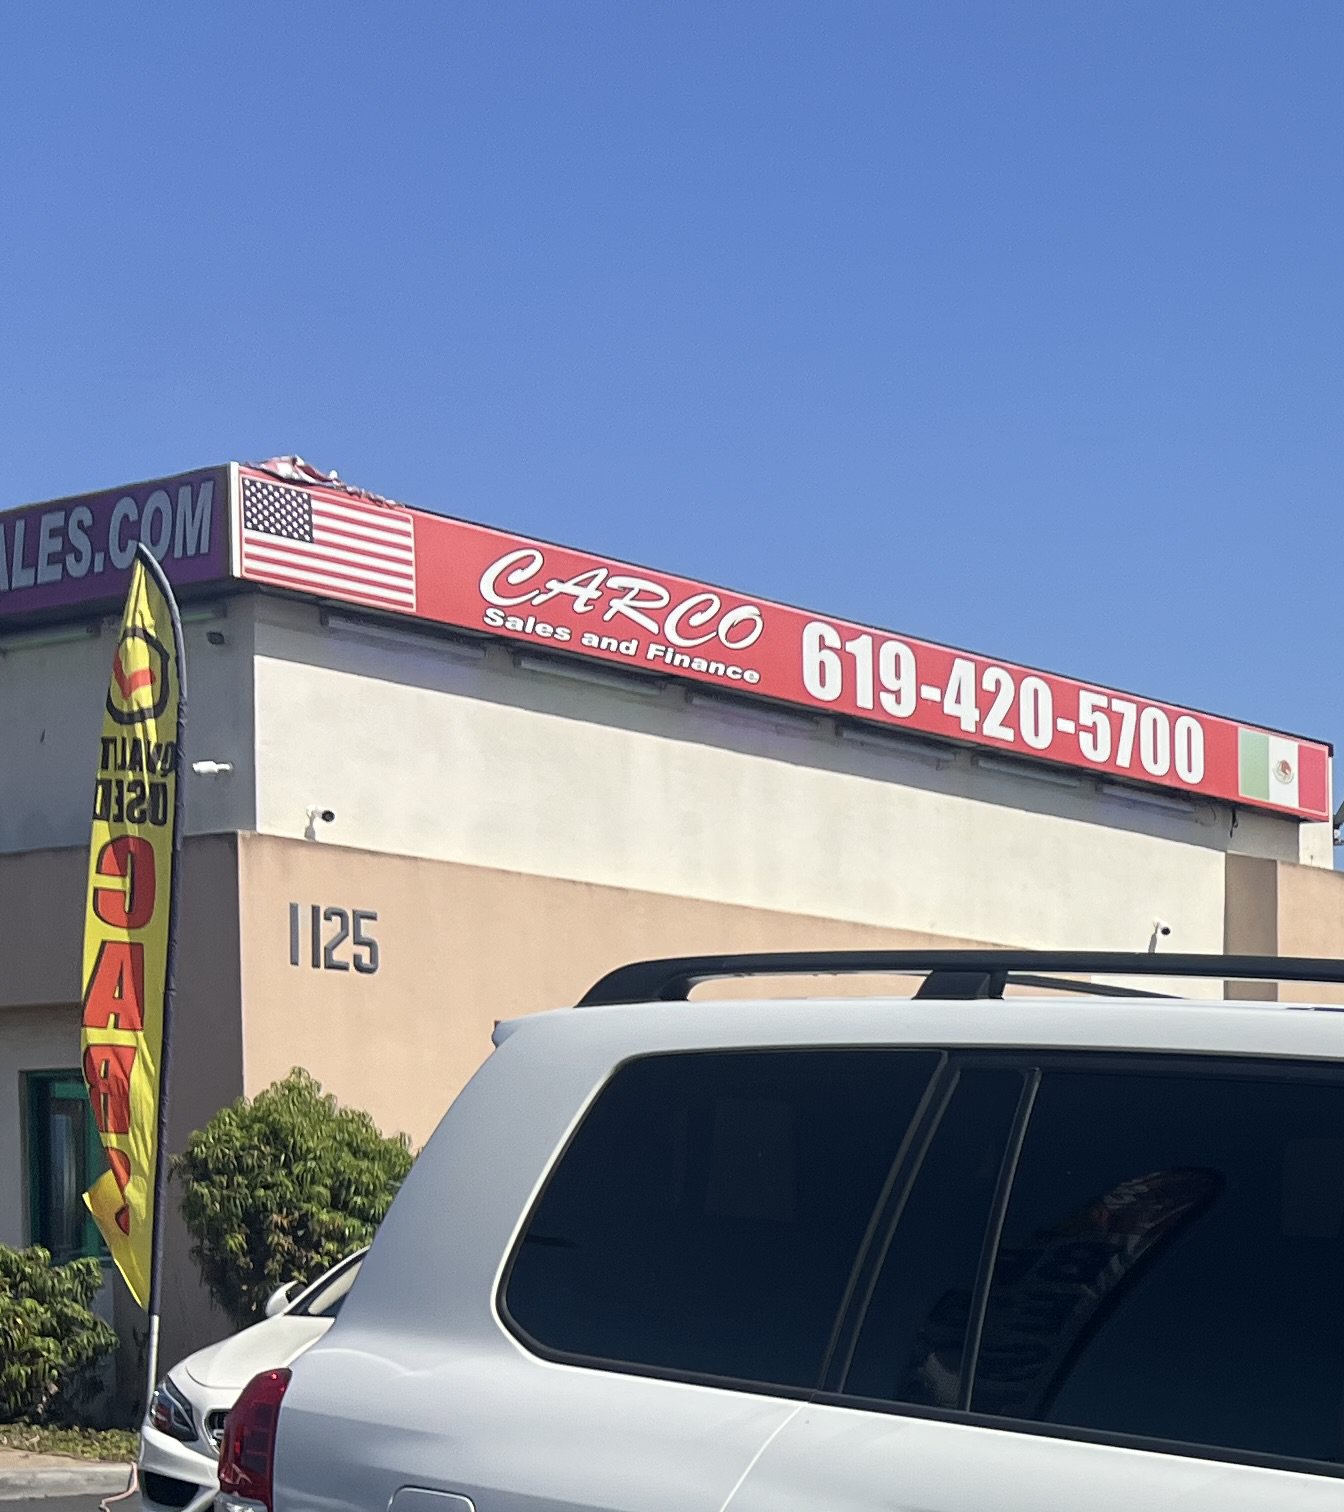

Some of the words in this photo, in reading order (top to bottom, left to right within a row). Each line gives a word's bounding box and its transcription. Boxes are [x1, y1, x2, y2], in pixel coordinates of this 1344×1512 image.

[479, 548, 764, 650] CARCO
[483, 607, 571, 641] Sales
[581, 632, 638, 656] and
[647, 643, 760, 684] Finance
[801, 620, 1204, 785] 619-420-5700
[289, 901, 379, 974] 1125
